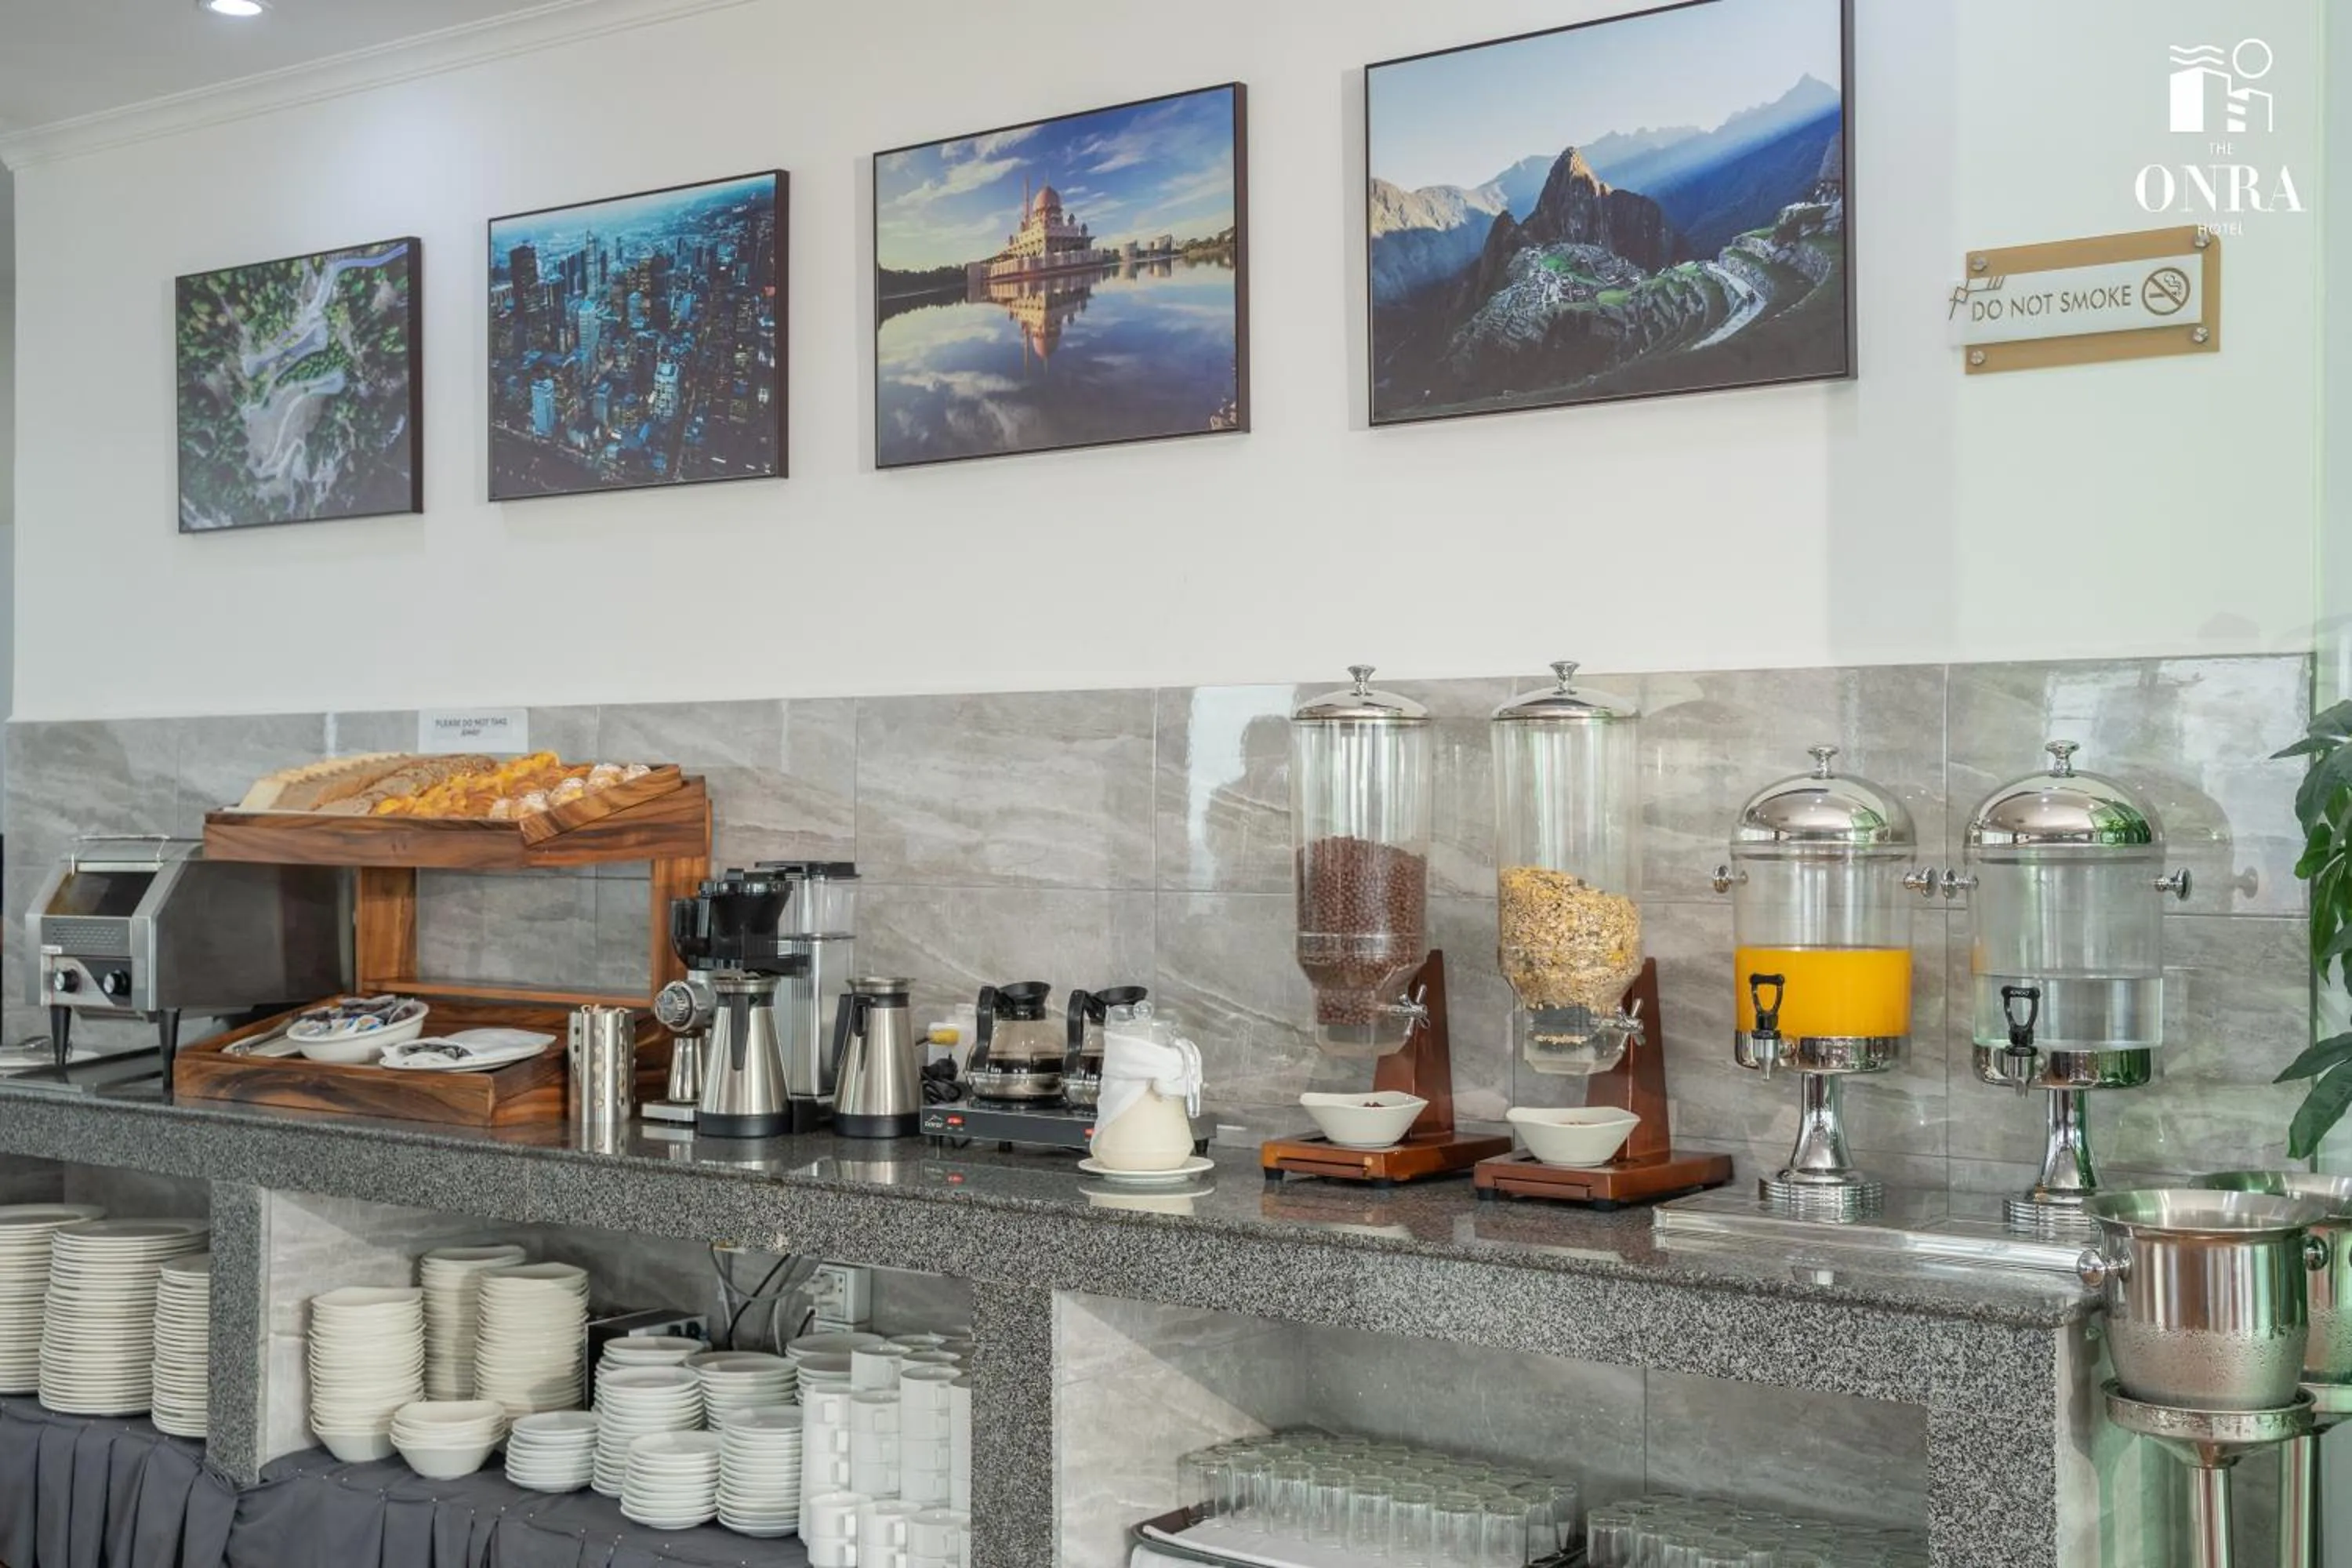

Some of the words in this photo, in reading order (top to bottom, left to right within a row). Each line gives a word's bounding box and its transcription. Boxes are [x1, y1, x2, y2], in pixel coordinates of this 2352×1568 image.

[1972, 299, 2002, 321] DO
[2010, 293, 2053, 316] NOT
[2060, 285, 2132, 312] SMOKE
[462, 718, 473, 727] DO
